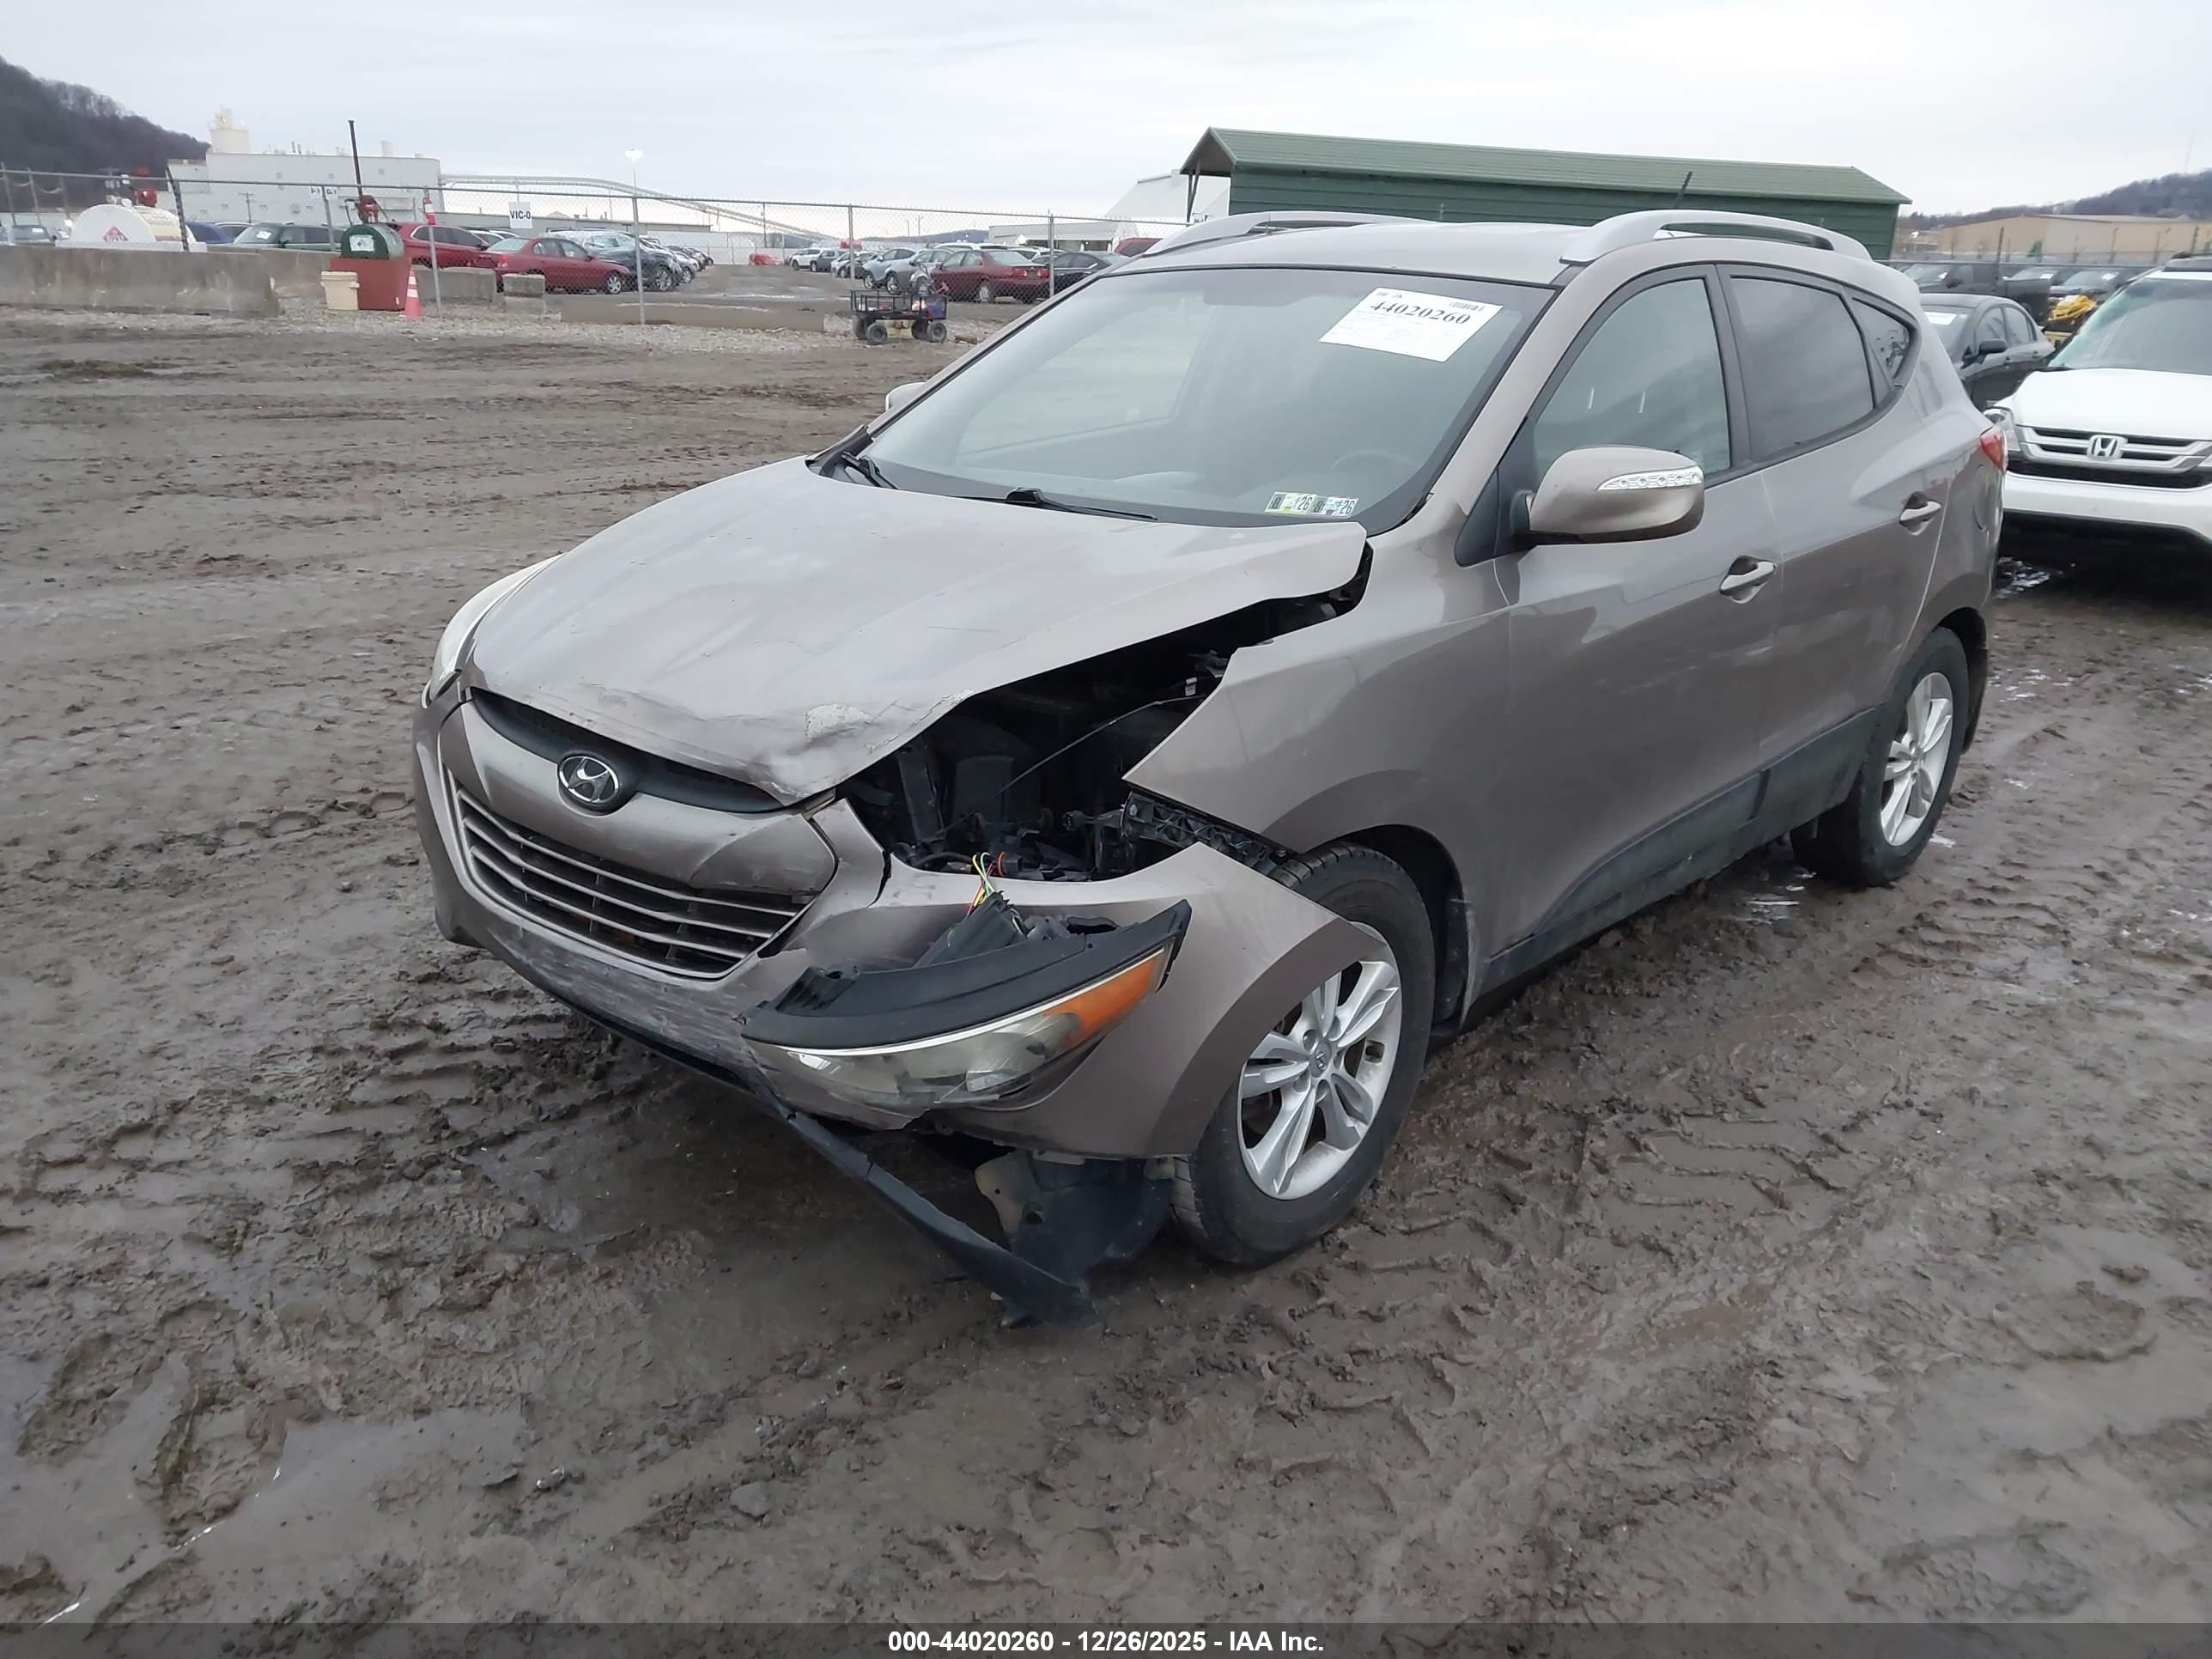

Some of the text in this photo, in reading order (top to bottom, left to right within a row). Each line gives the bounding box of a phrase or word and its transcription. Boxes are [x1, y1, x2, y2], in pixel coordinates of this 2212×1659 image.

[1370, 301, 1471, 325] 44020260
[1297, 496, 1312, 510] 26
[1340, 500, 1355, 514] 26
